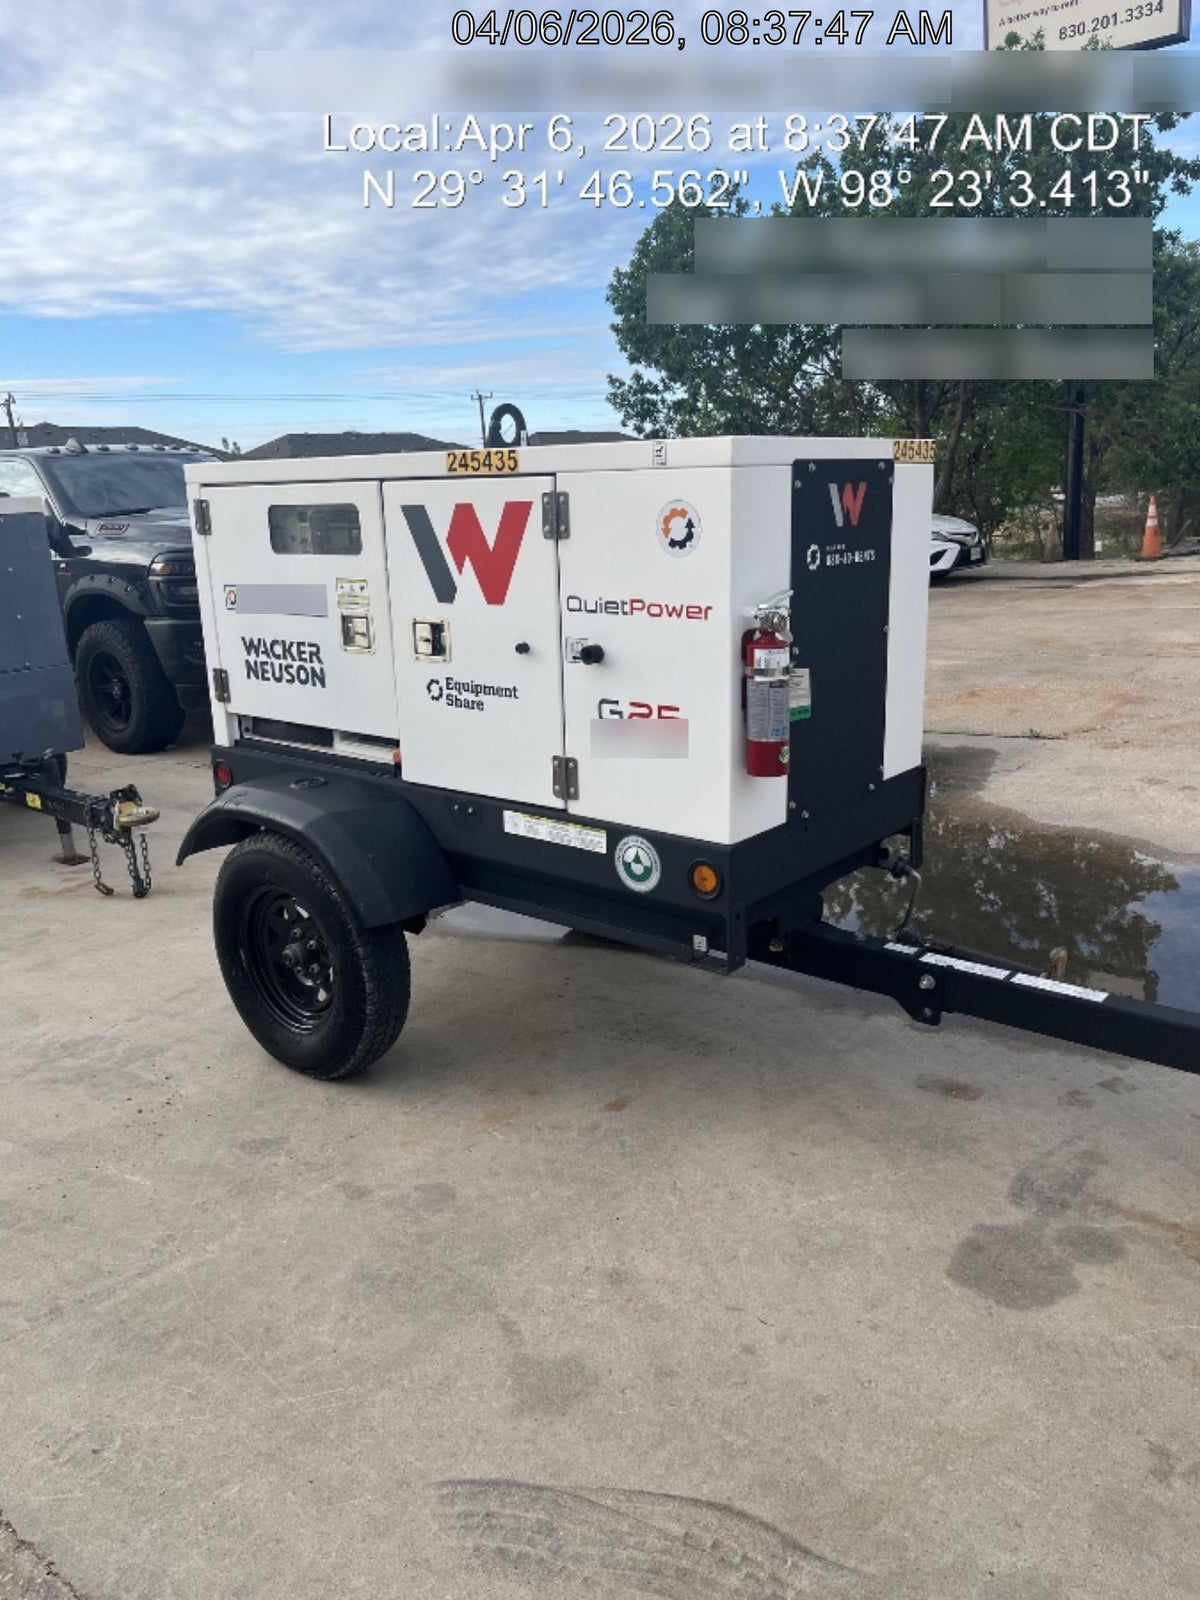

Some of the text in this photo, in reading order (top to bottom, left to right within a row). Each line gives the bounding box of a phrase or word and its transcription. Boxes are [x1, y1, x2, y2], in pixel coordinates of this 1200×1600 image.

[1058, 0, 1164, 40] 830.201.3334
[447, 450, 519, 472] 245435
[893, 440, 936, 461] 245435
[566, 595, 713, 621] QuietPower
[241, 636, 323, 664] WACKER
[244, 659, 326, 689] NEUSON
[445, 677, 519, 700] Equipment
[445, 694, 485, 712] Share
